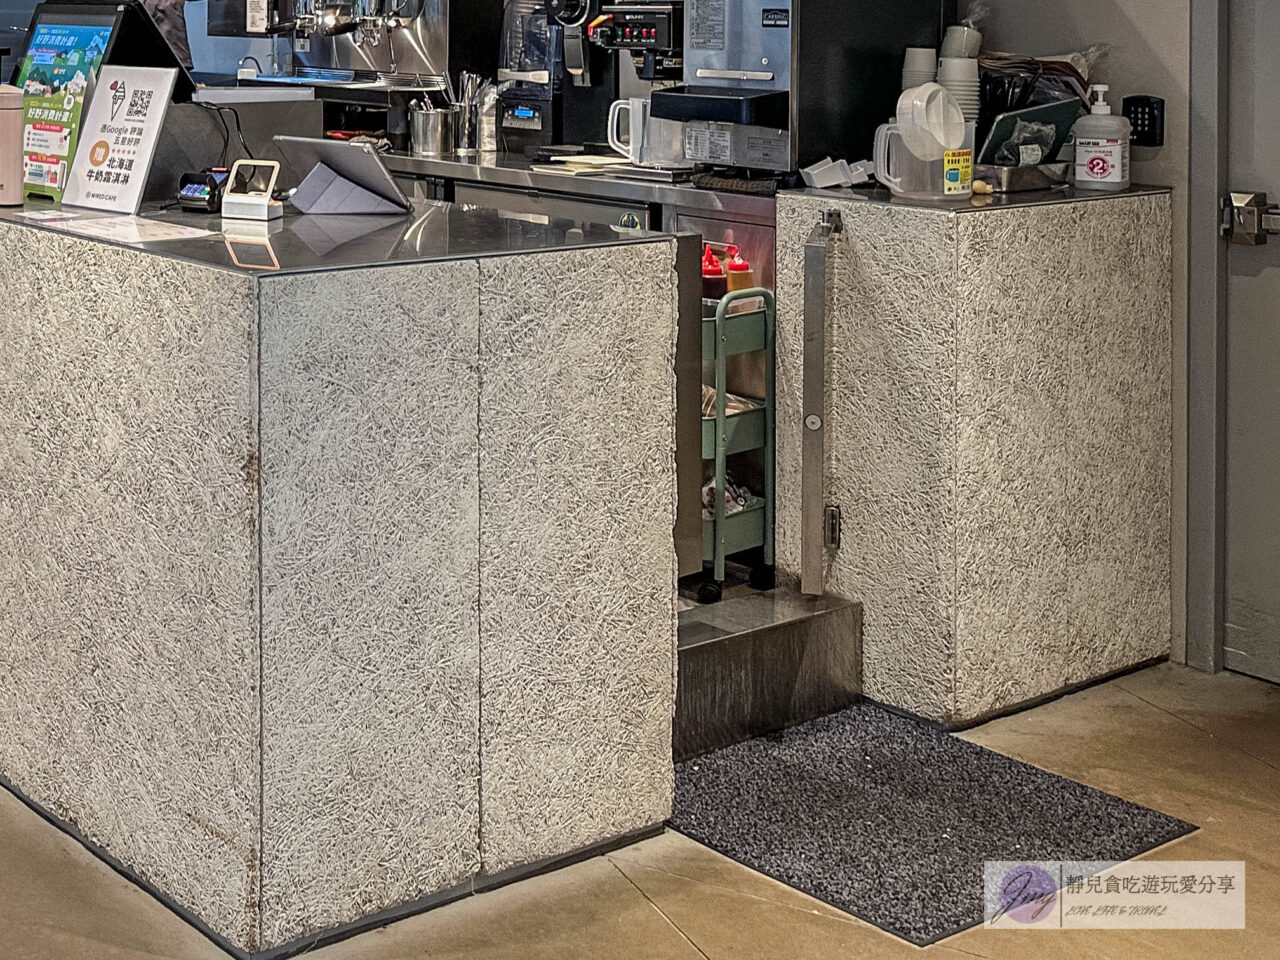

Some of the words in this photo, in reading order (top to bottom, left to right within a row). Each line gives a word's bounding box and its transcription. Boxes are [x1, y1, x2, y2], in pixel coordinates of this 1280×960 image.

[106, 157, 135, 171] 北海道
[86, 169, 130, 185] 牛奶霜淇淋
